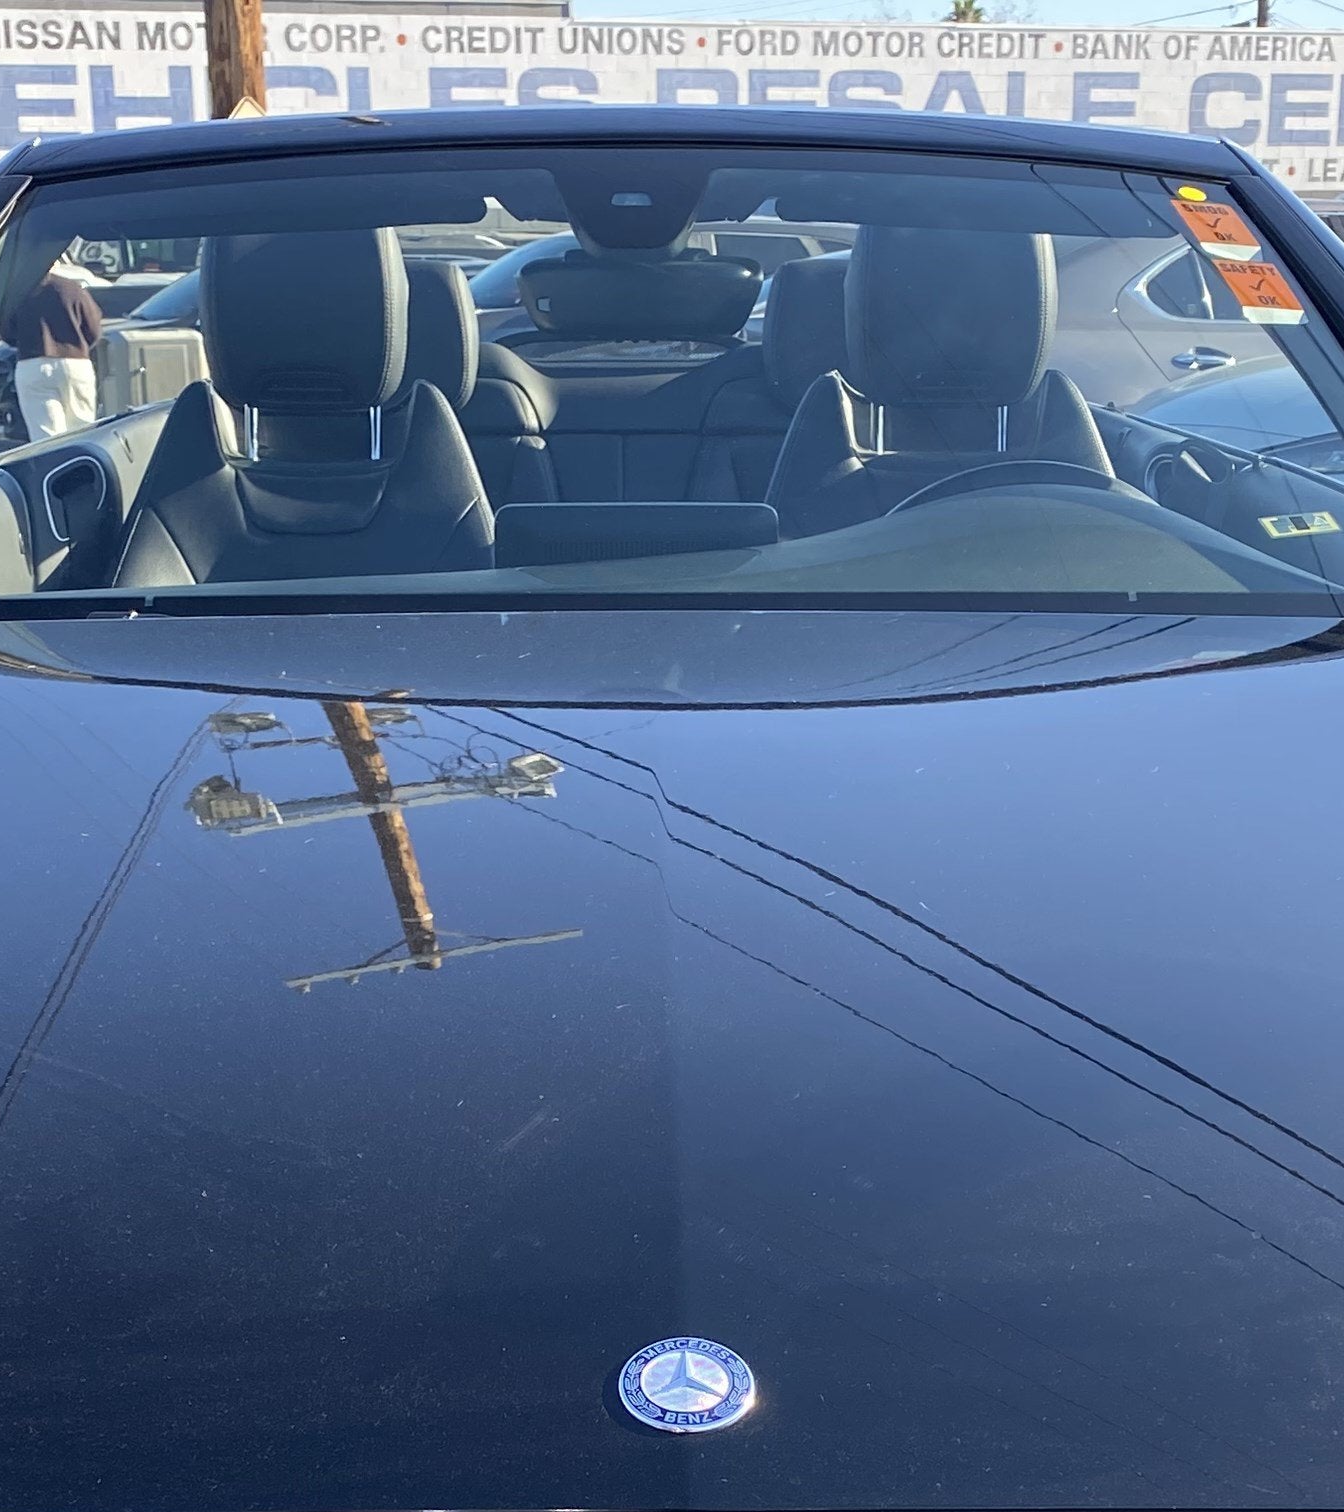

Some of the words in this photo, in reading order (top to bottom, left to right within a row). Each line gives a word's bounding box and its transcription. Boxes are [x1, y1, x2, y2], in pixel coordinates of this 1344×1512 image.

[284, 22, 386, 53] CORP.
[421, 24, 544, 54] CREDIT
[558, 26, 685, 56] UNIONS
[716, 29, 800, 57] FORD
[812, 30, 925, 58] MOTOR
[937, 31, 1046, 59] CREDIT
[1072, 33, 1151, 60] BANK
[1163, 35, 1199, 61] OF
[1207, 36, 1336, 63] AMERICA
[1217, 262, 1277, 276] SAFETY
[1257, 295, 1282, 306] OK
[641, 1339, 730, 1360] MERCEDES
[663, 1411, 713, 1425] BENZ
